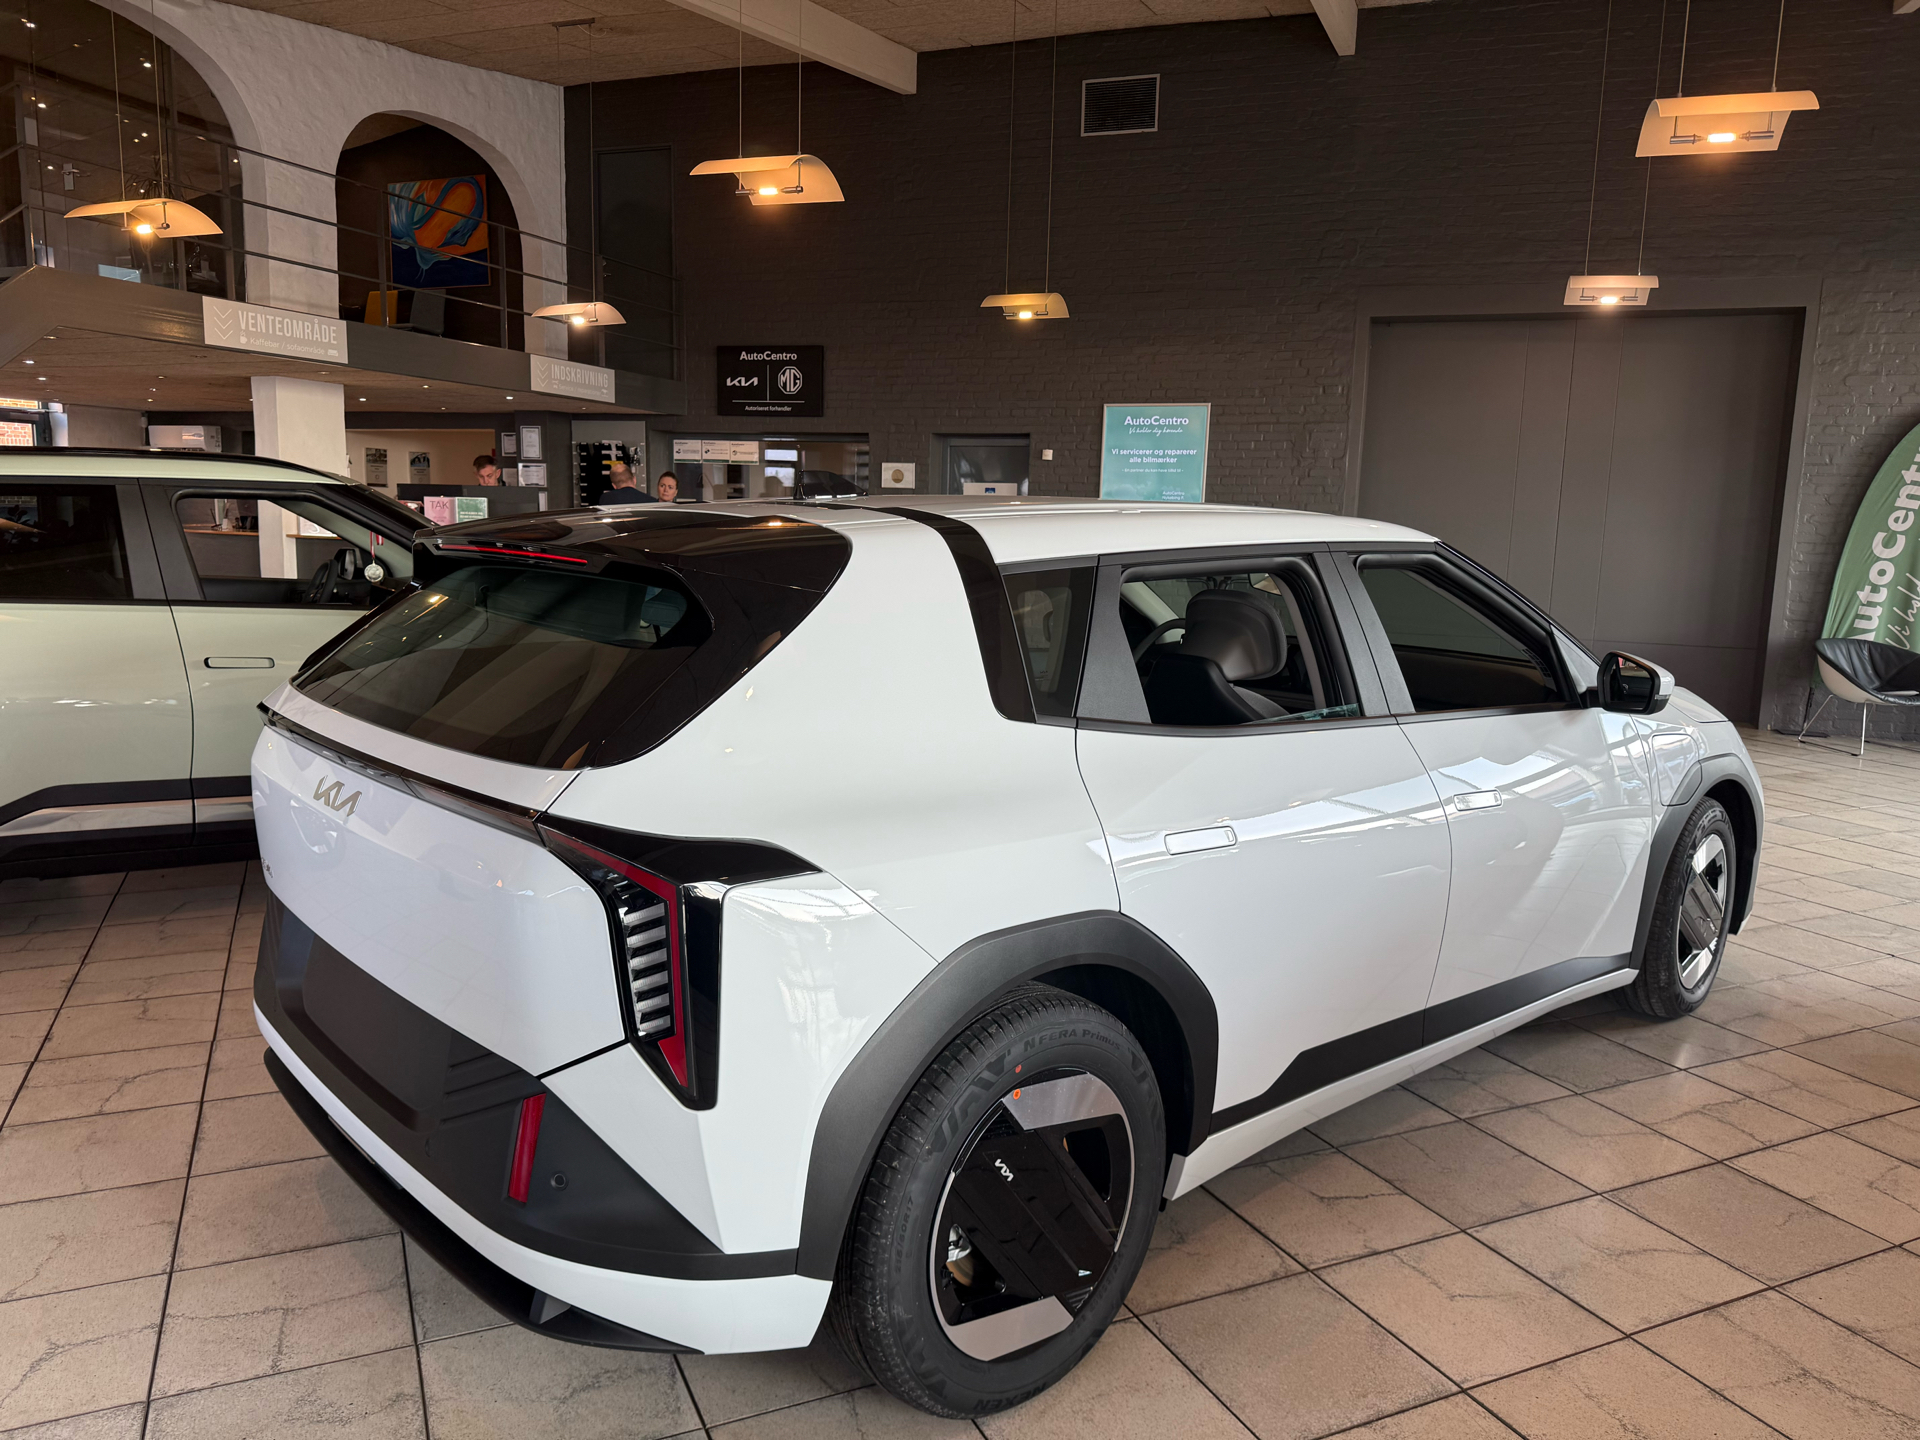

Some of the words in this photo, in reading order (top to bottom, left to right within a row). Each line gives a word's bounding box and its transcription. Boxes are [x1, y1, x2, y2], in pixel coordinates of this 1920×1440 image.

[239, 311, 337, 344] VENTEOMRÅDE
[250, 337, 280, 348] Kaffebar
[287, 343, 325, 355] sofaområde
[740, 351, 797, 360] AutoCentro
[551, 364, 608, 387] INDSKRIVNING
[780, 368, 801, 392] MG
[1124, 416, 1189, 425] AutoCentro
[430, 501, 449, 509] TAK
[1847, 447, 1920, 642] utoCent
[313, 775, 362, 817] KIA
[1082, 1029, 1120, 1050] Primus
[973, 1382, 1047, 1411] NEXEN
